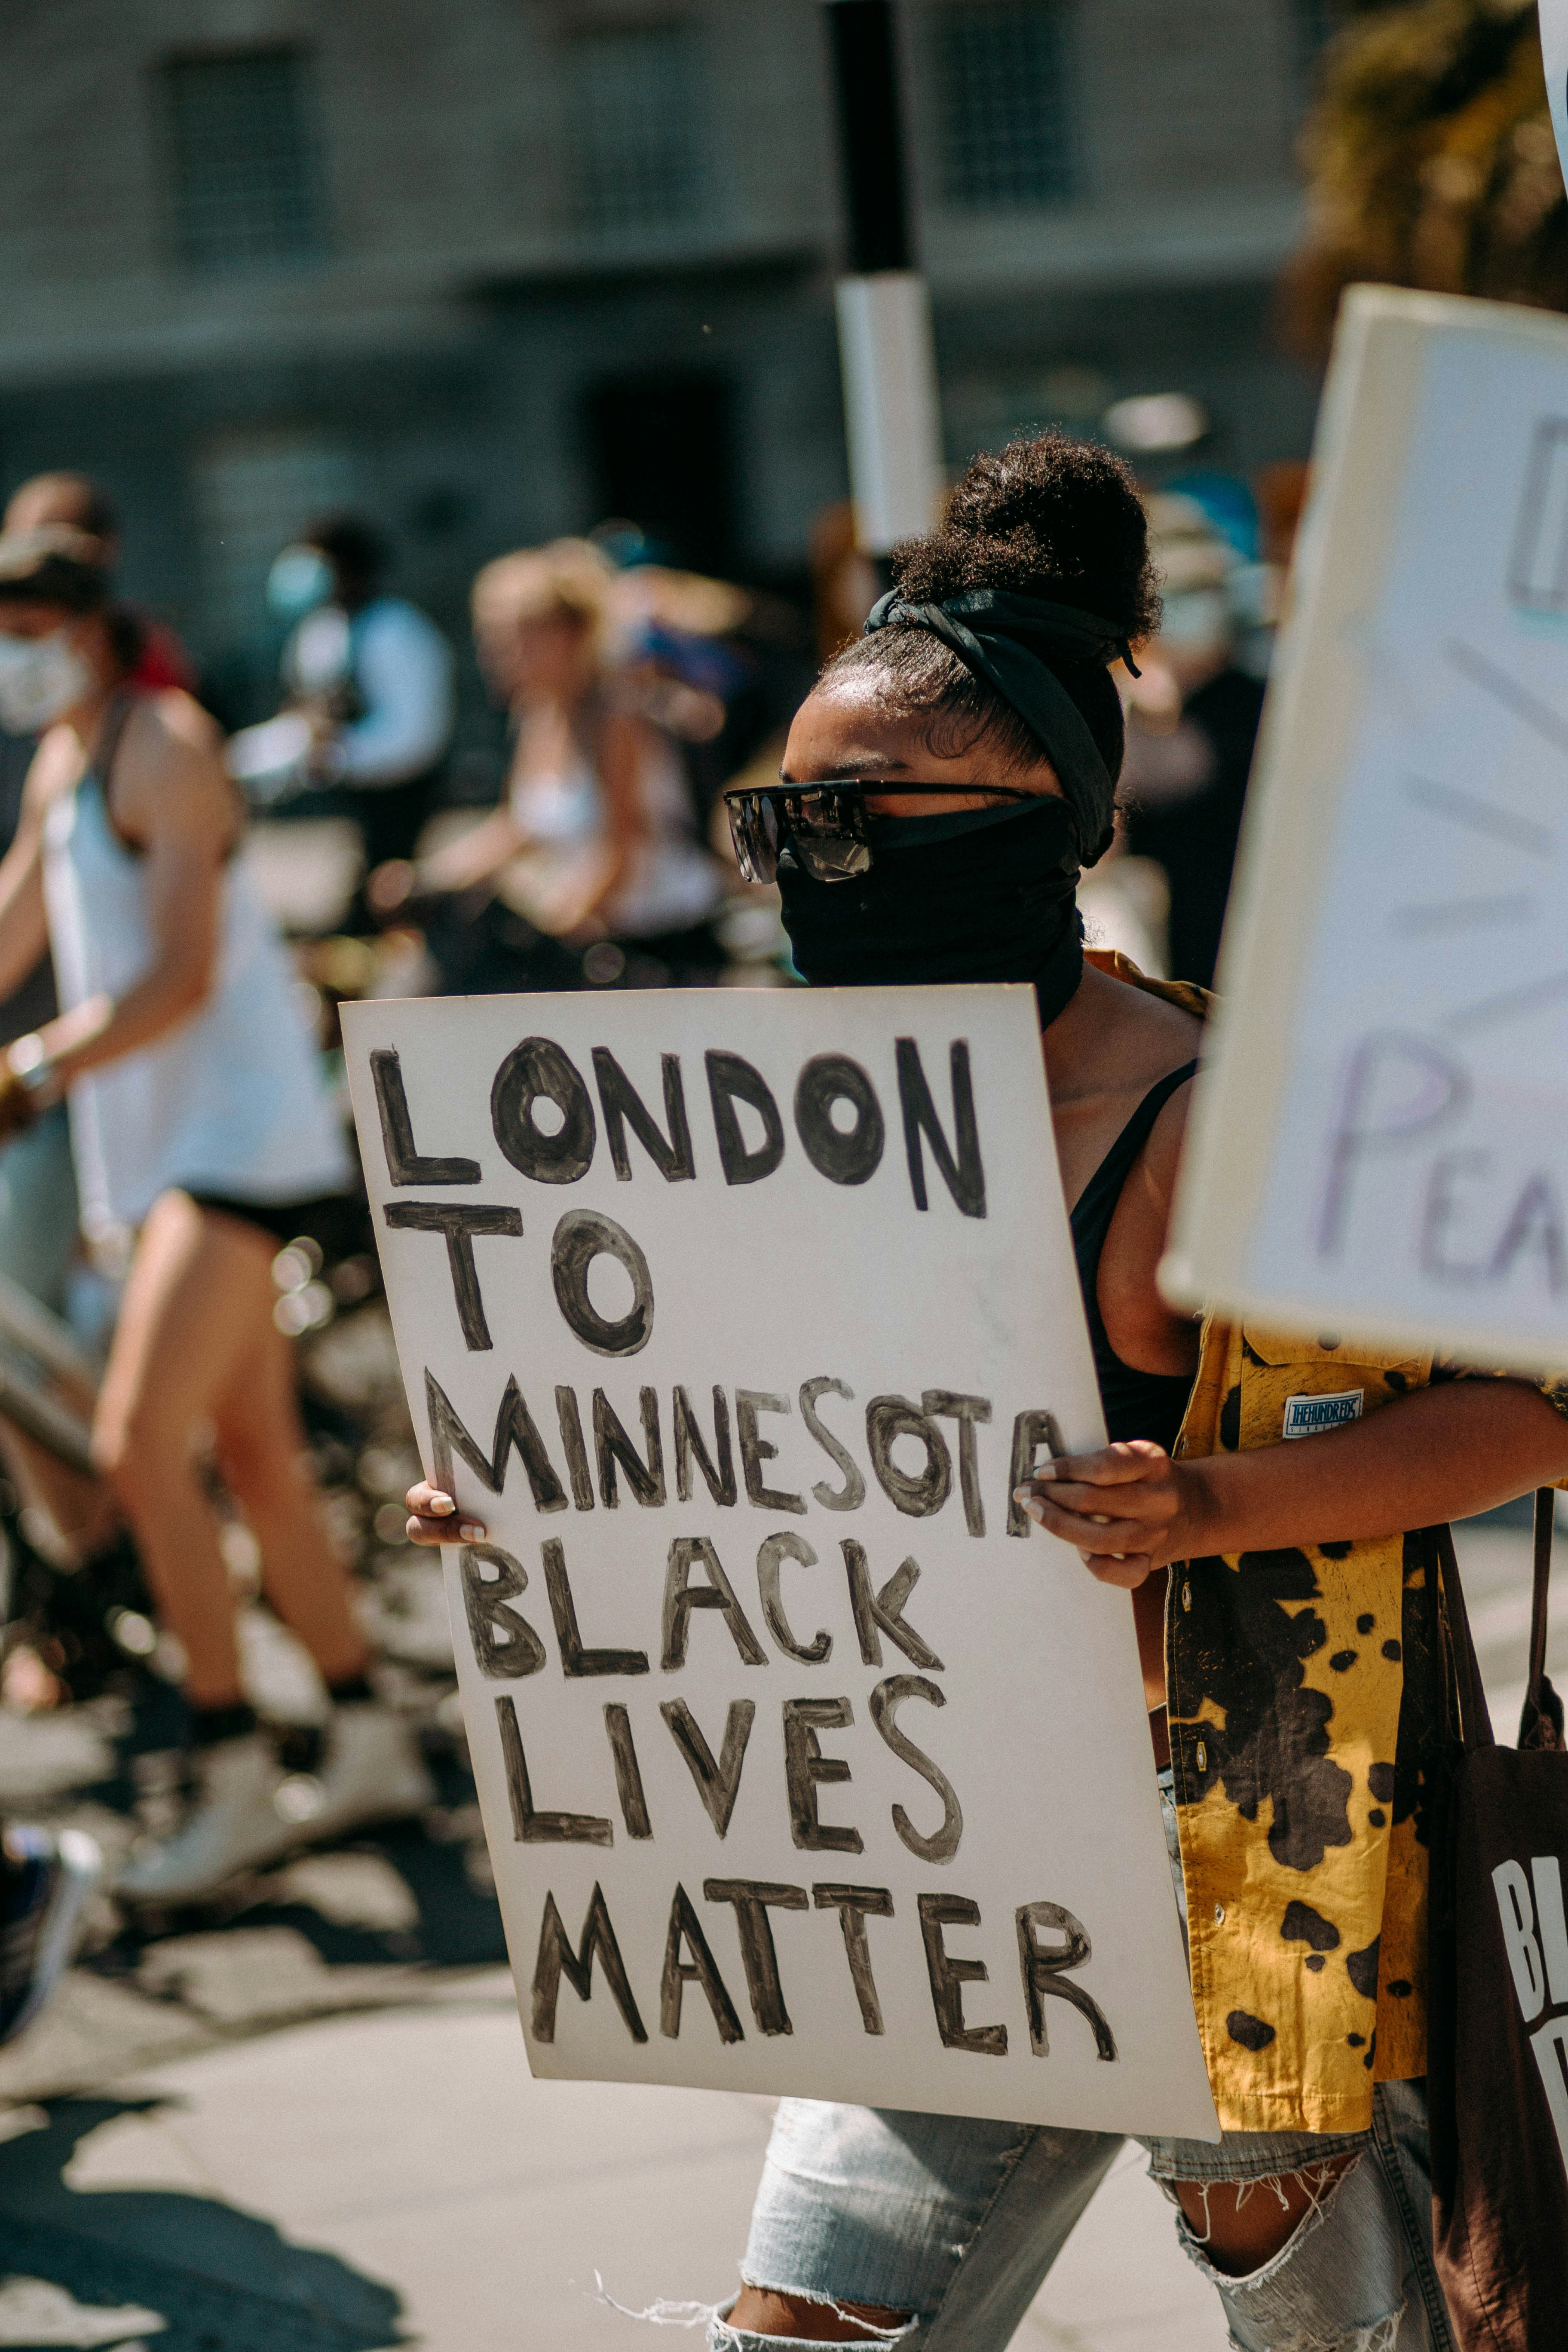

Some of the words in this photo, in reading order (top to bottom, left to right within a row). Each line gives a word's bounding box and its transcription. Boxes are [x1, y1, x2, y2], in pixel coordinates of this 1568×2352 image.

[369, 1035, 988, 1220] LONDON
[383, 1199, 654, 1358] TO
[424, 1366, 1070, 1538] MINNESOTA
[458, 1531, 946, 1680] BLACK
[494, 1674, 963, 1865] LIVES
[531, 1878, 1119, 2063] MATTER
